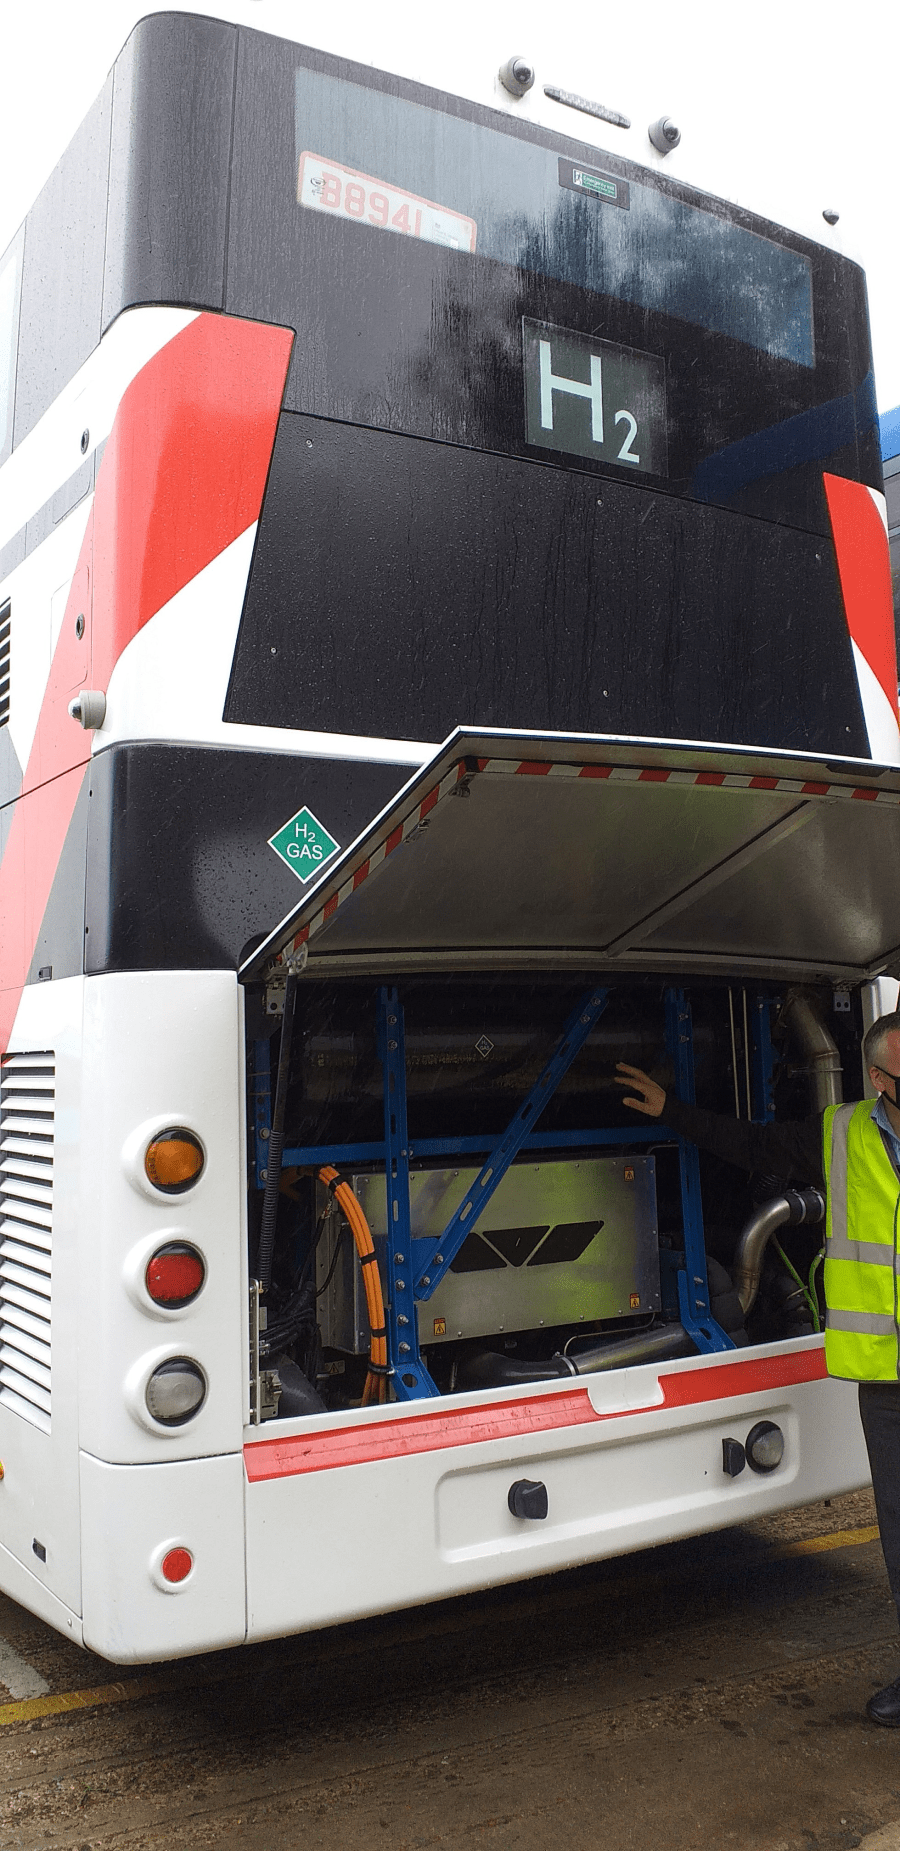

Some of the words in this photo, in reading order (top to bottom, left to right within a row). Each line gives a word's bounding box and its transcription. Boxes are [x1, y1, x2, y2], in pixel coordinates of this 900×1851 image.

[539, 339, 640, 464] H2
[295, 822, 316, 843] H2
[286, 843, 323, 860] GAS
